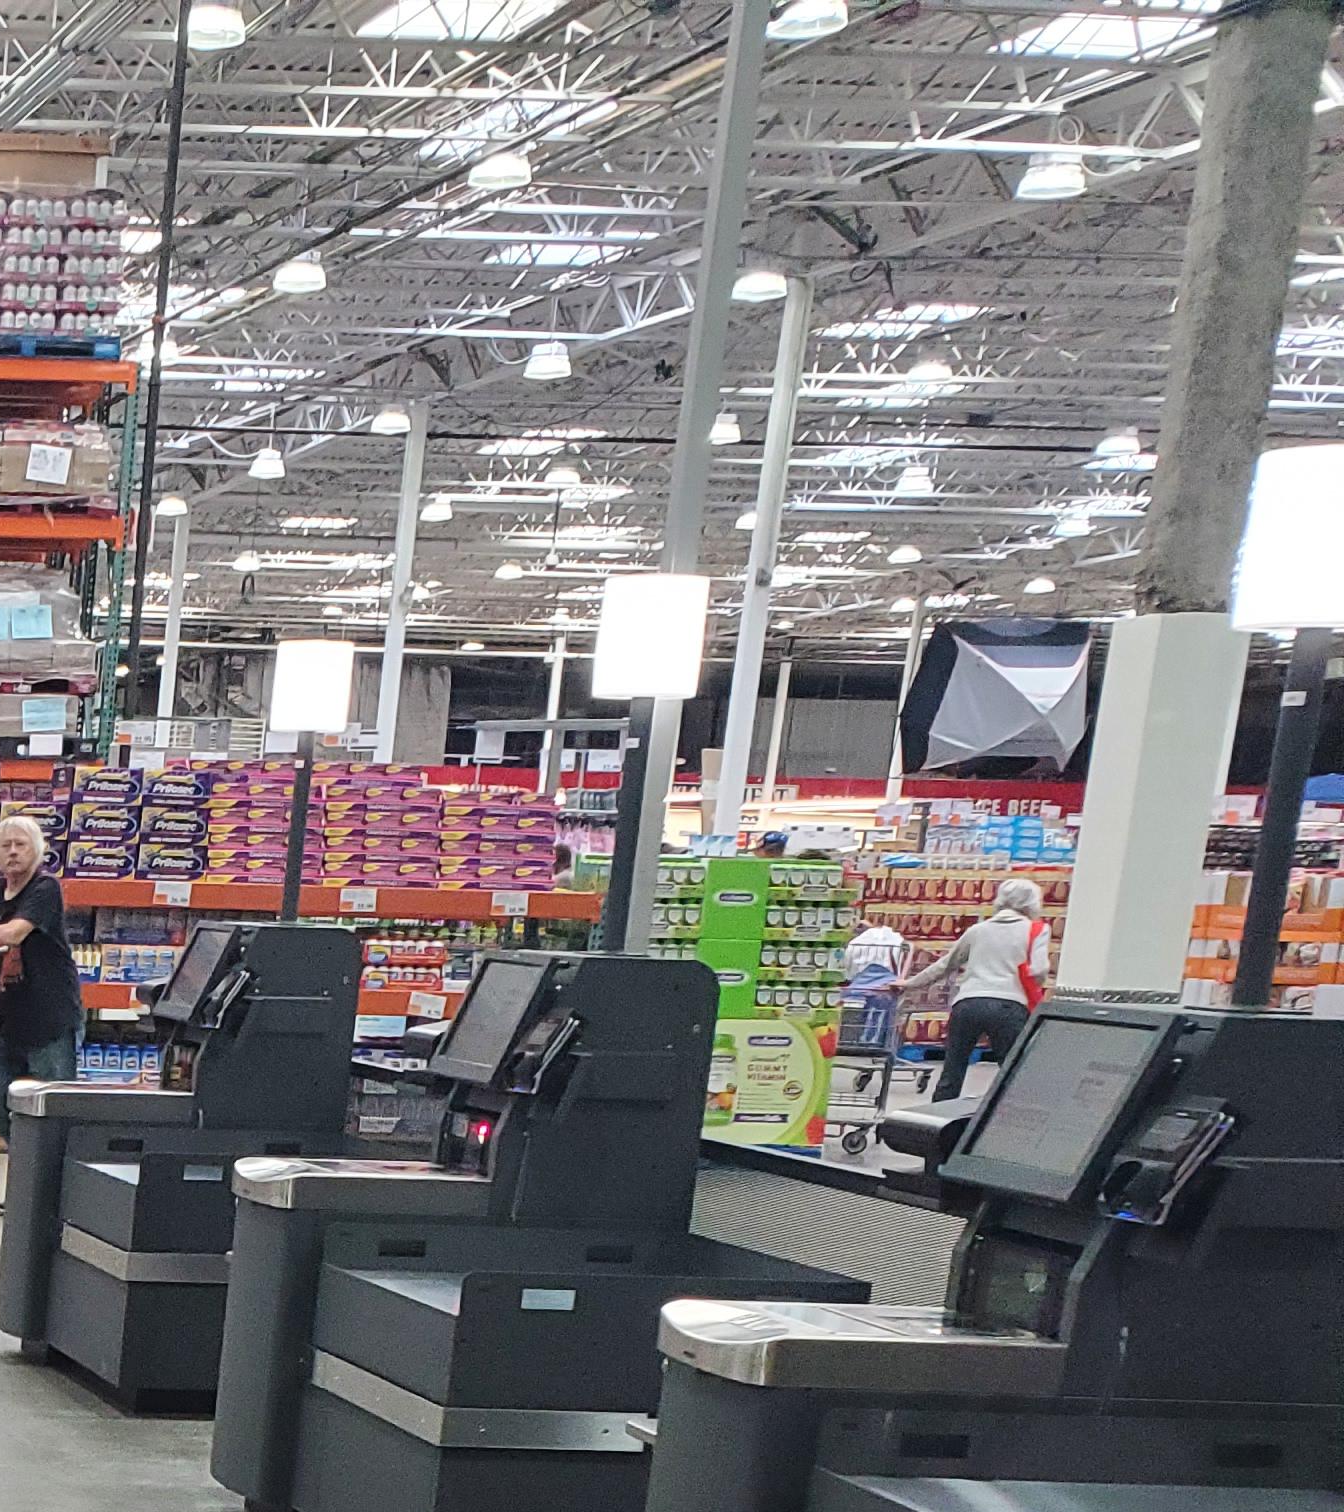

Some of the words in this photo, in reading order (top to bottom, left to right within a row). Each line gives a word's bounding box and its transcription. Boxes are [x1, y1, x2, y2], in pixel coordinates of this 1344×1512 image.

[87, 781, 131, 793] Prilosec
[152, 782, 196, 795] Prilosec
[85, 819, 128, 831] Prilosec
[155, 820, 197, 832] Prilosec
[82, 855, 126, 868] Prilosec
[152, 858, 196, 871] Prilosec
[747, 1064, 787, 1072] GUMMY
[747, 1073, 786, 1081] VITAMIN
